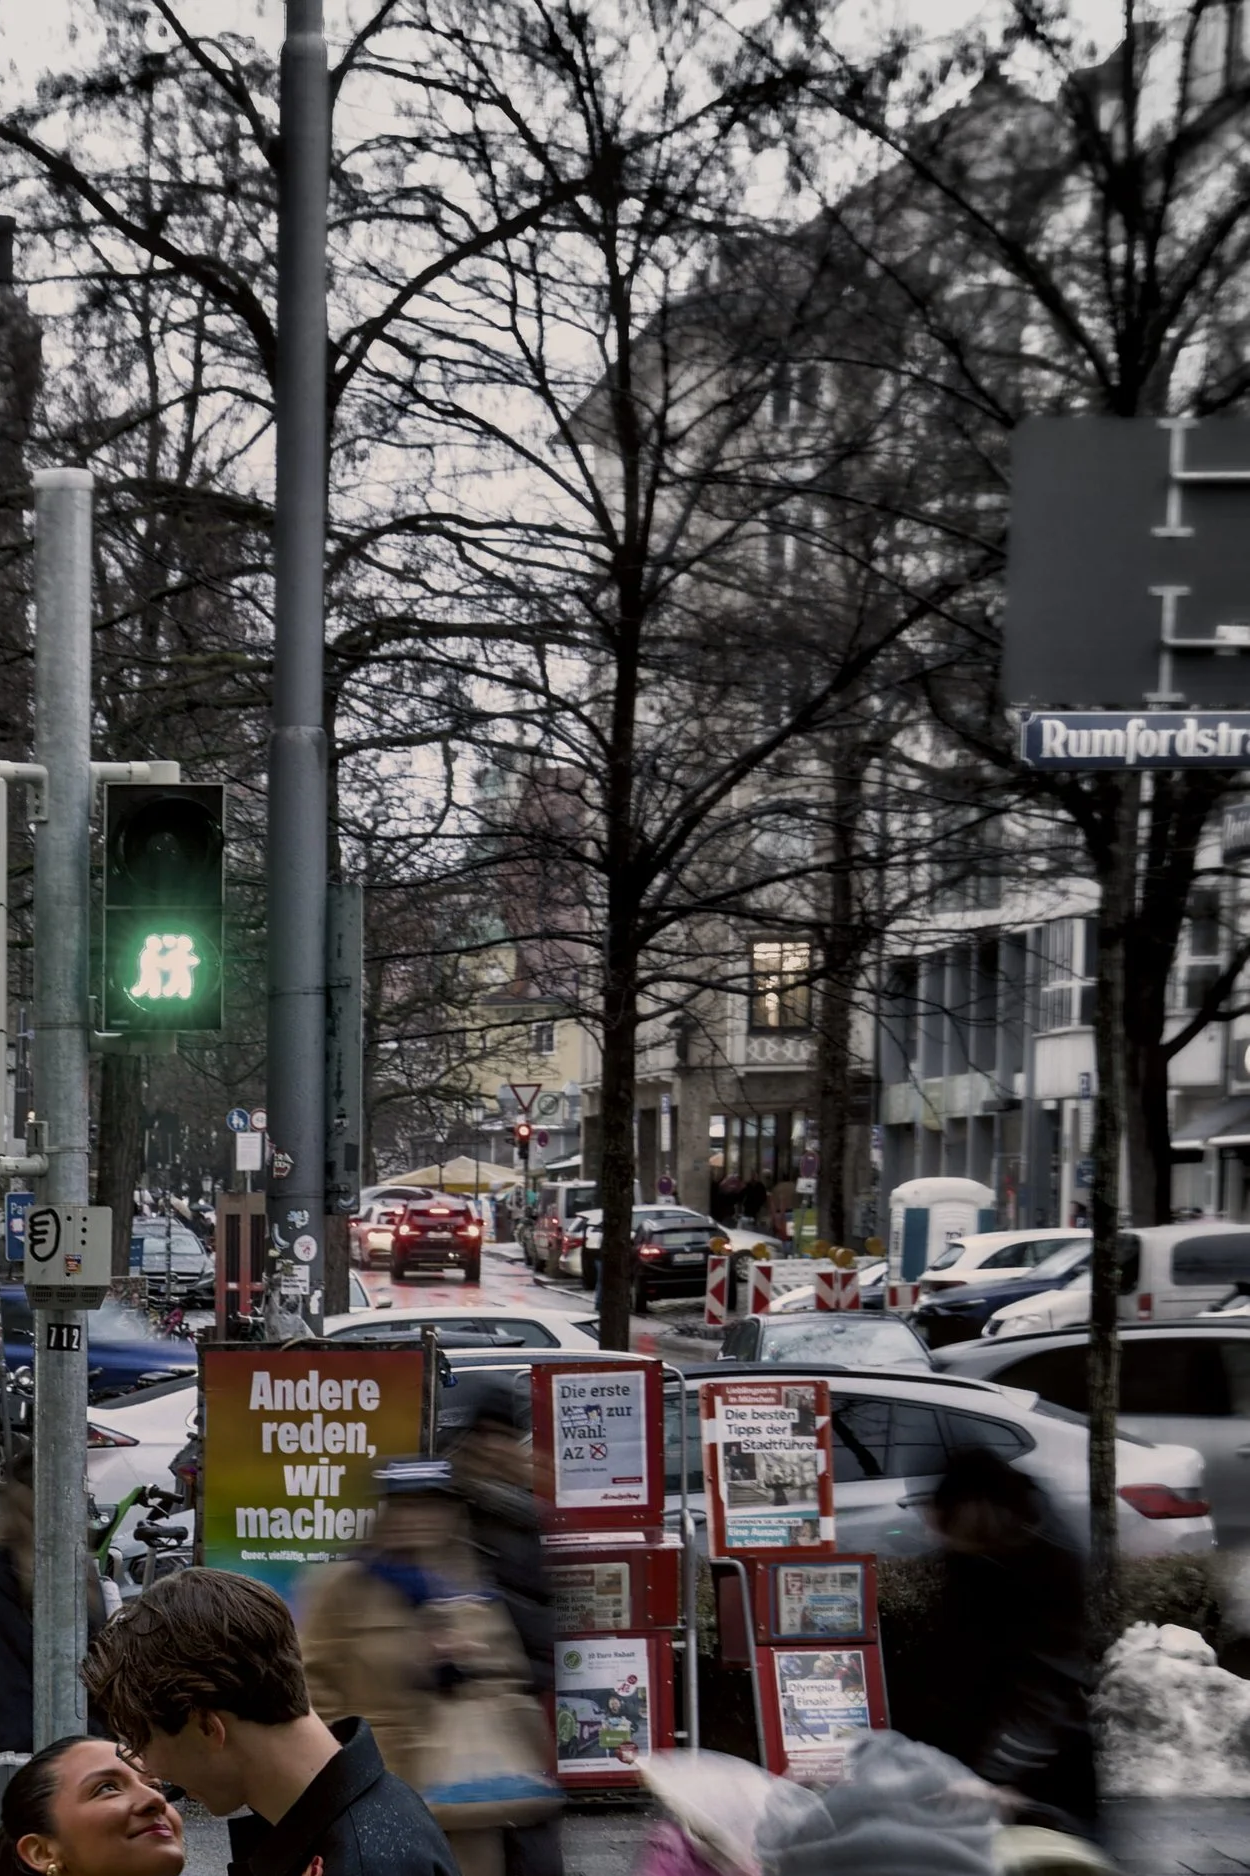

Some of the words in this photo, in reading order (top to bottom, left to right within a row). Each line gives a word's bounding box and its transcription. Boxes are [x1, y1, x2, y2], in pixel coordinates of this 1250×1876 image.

[1039, 718, 1250, 765] Rumfordstr
[49, 1326, 80, 1349] 712
[249, 1370, 381, 1411] Andere
[561, 1386, 586, 1398] Die
[590, 1384, 630, 1397] erste
[607, 1406, 632, 1417] zur
[725, 1409, 747, 1420] Die
[751, 1408, 796, 1420] besten
[261, 1413, 377, 1459] reden,
[562, 1424, 606, 1439] Wahl:
[726, 1424, 762, 1437] Tipps
[766, 1423, 788, 1435] der
[743, 1439, 817, 1450] Stadtführe
[563, 1447, 584, 1460] AZ
[283, 1457, 346, 1497] wir
